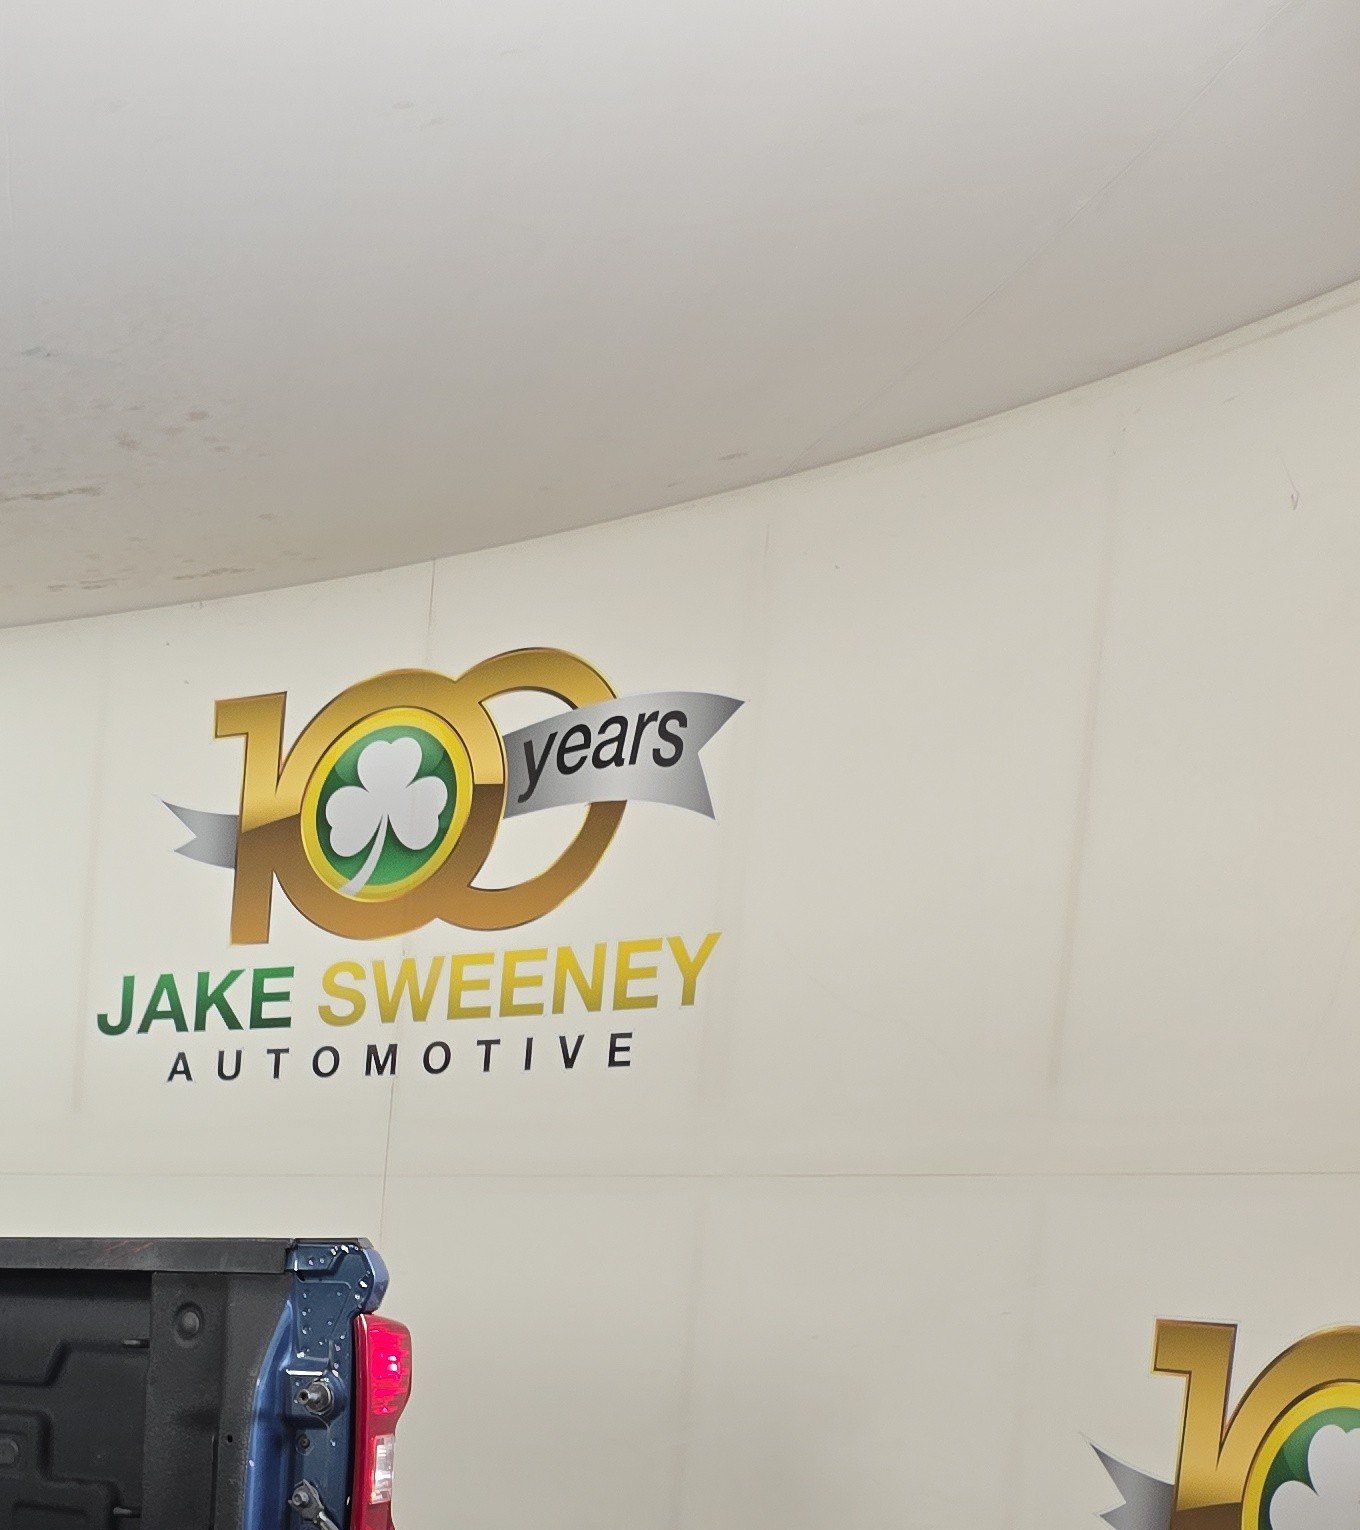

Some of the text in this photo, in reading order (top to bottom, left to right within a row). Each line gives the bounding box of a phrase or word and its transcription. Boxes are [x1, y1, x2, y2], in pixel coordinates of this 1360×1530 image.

[214, 647, 688, 946] 100 years
[96, 931, 722, 1036] JAKE SWEENEY
[166, 1031, 635, 1084] AUTOMOTIVE
